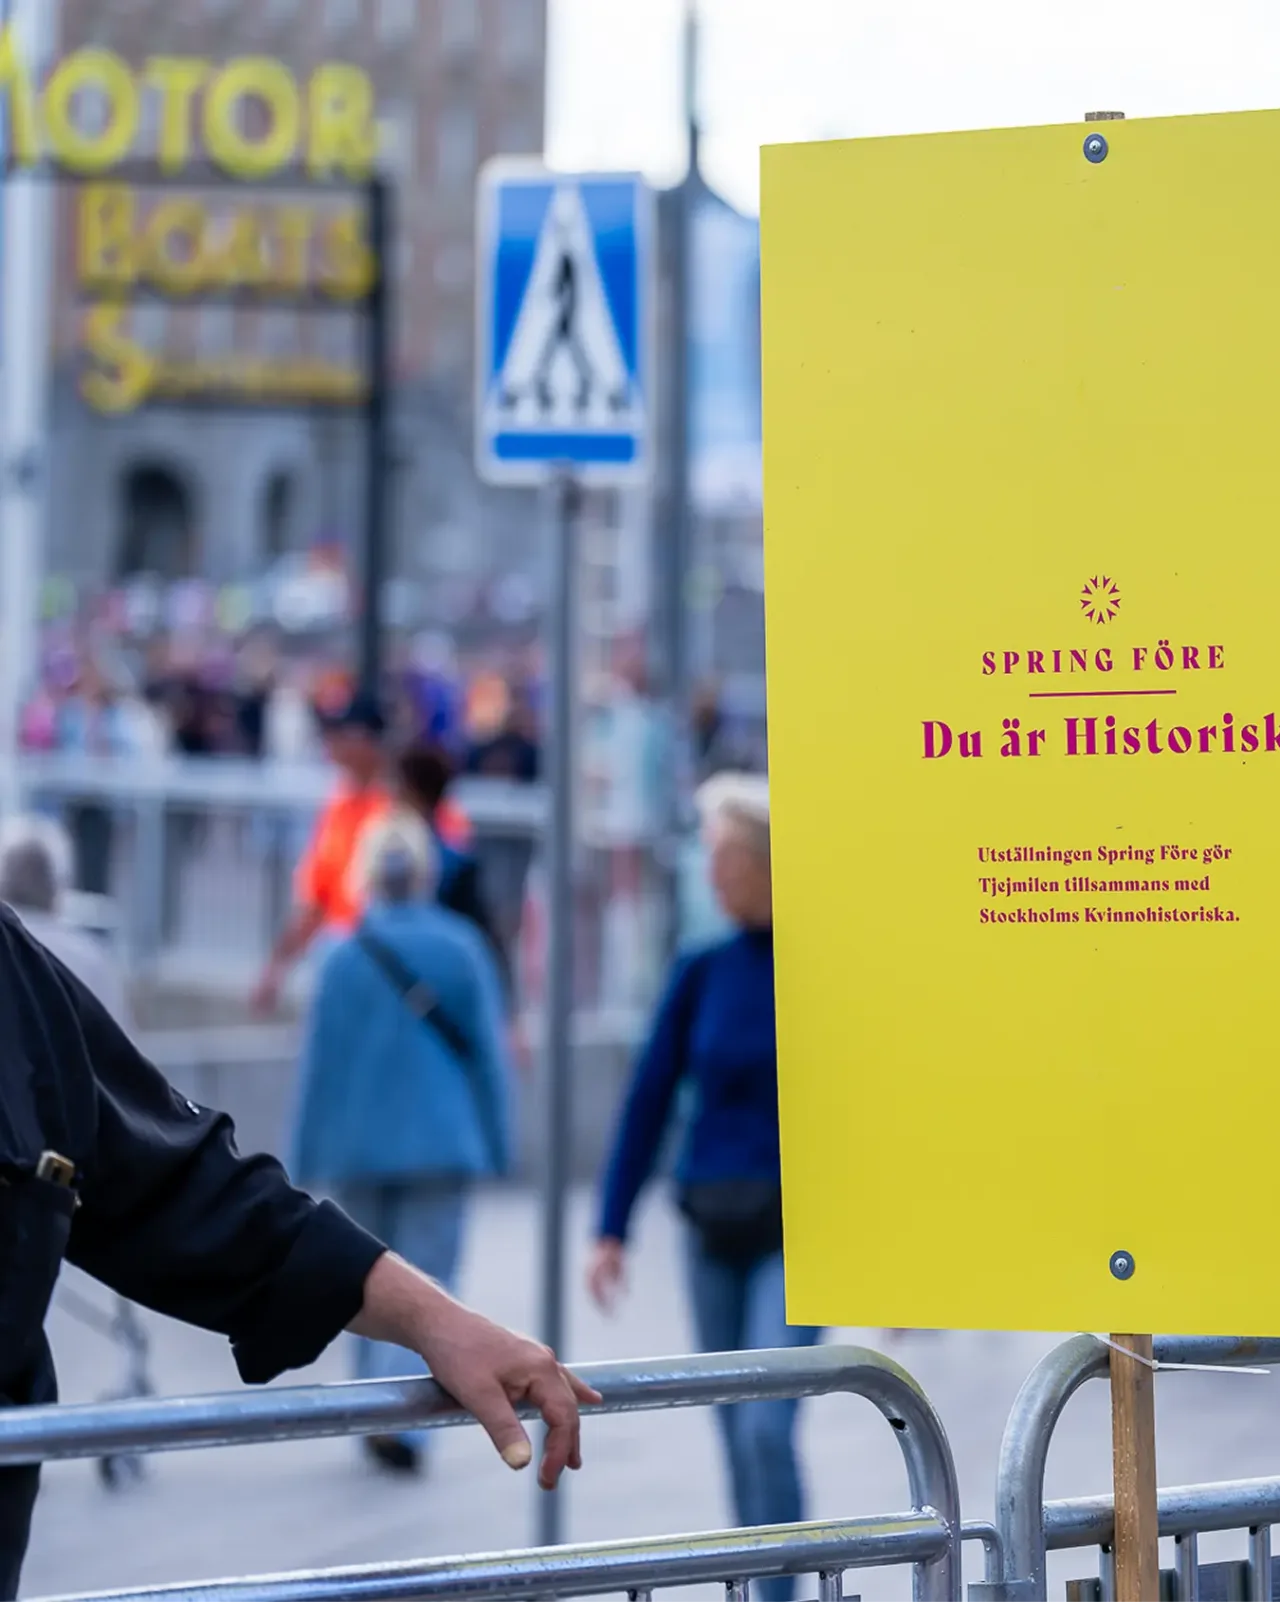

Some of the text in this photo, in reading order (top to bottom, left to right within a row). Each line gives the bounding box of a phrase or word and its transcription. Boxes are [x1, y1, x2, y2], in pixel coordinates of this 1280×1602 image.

[982, 639, 1225, 675] SPRING FÖRE
[921, 720, 982, 758] Du
[1000, 718, 1046, 757] är
[978, 845, 1232, 866] Utställningen Spring Före gör
[979, 876, 1210, 897] Tjejmilen tillsammans med
[979, 906, 1240, 924] Stockholms Kvinnohistoriska.
